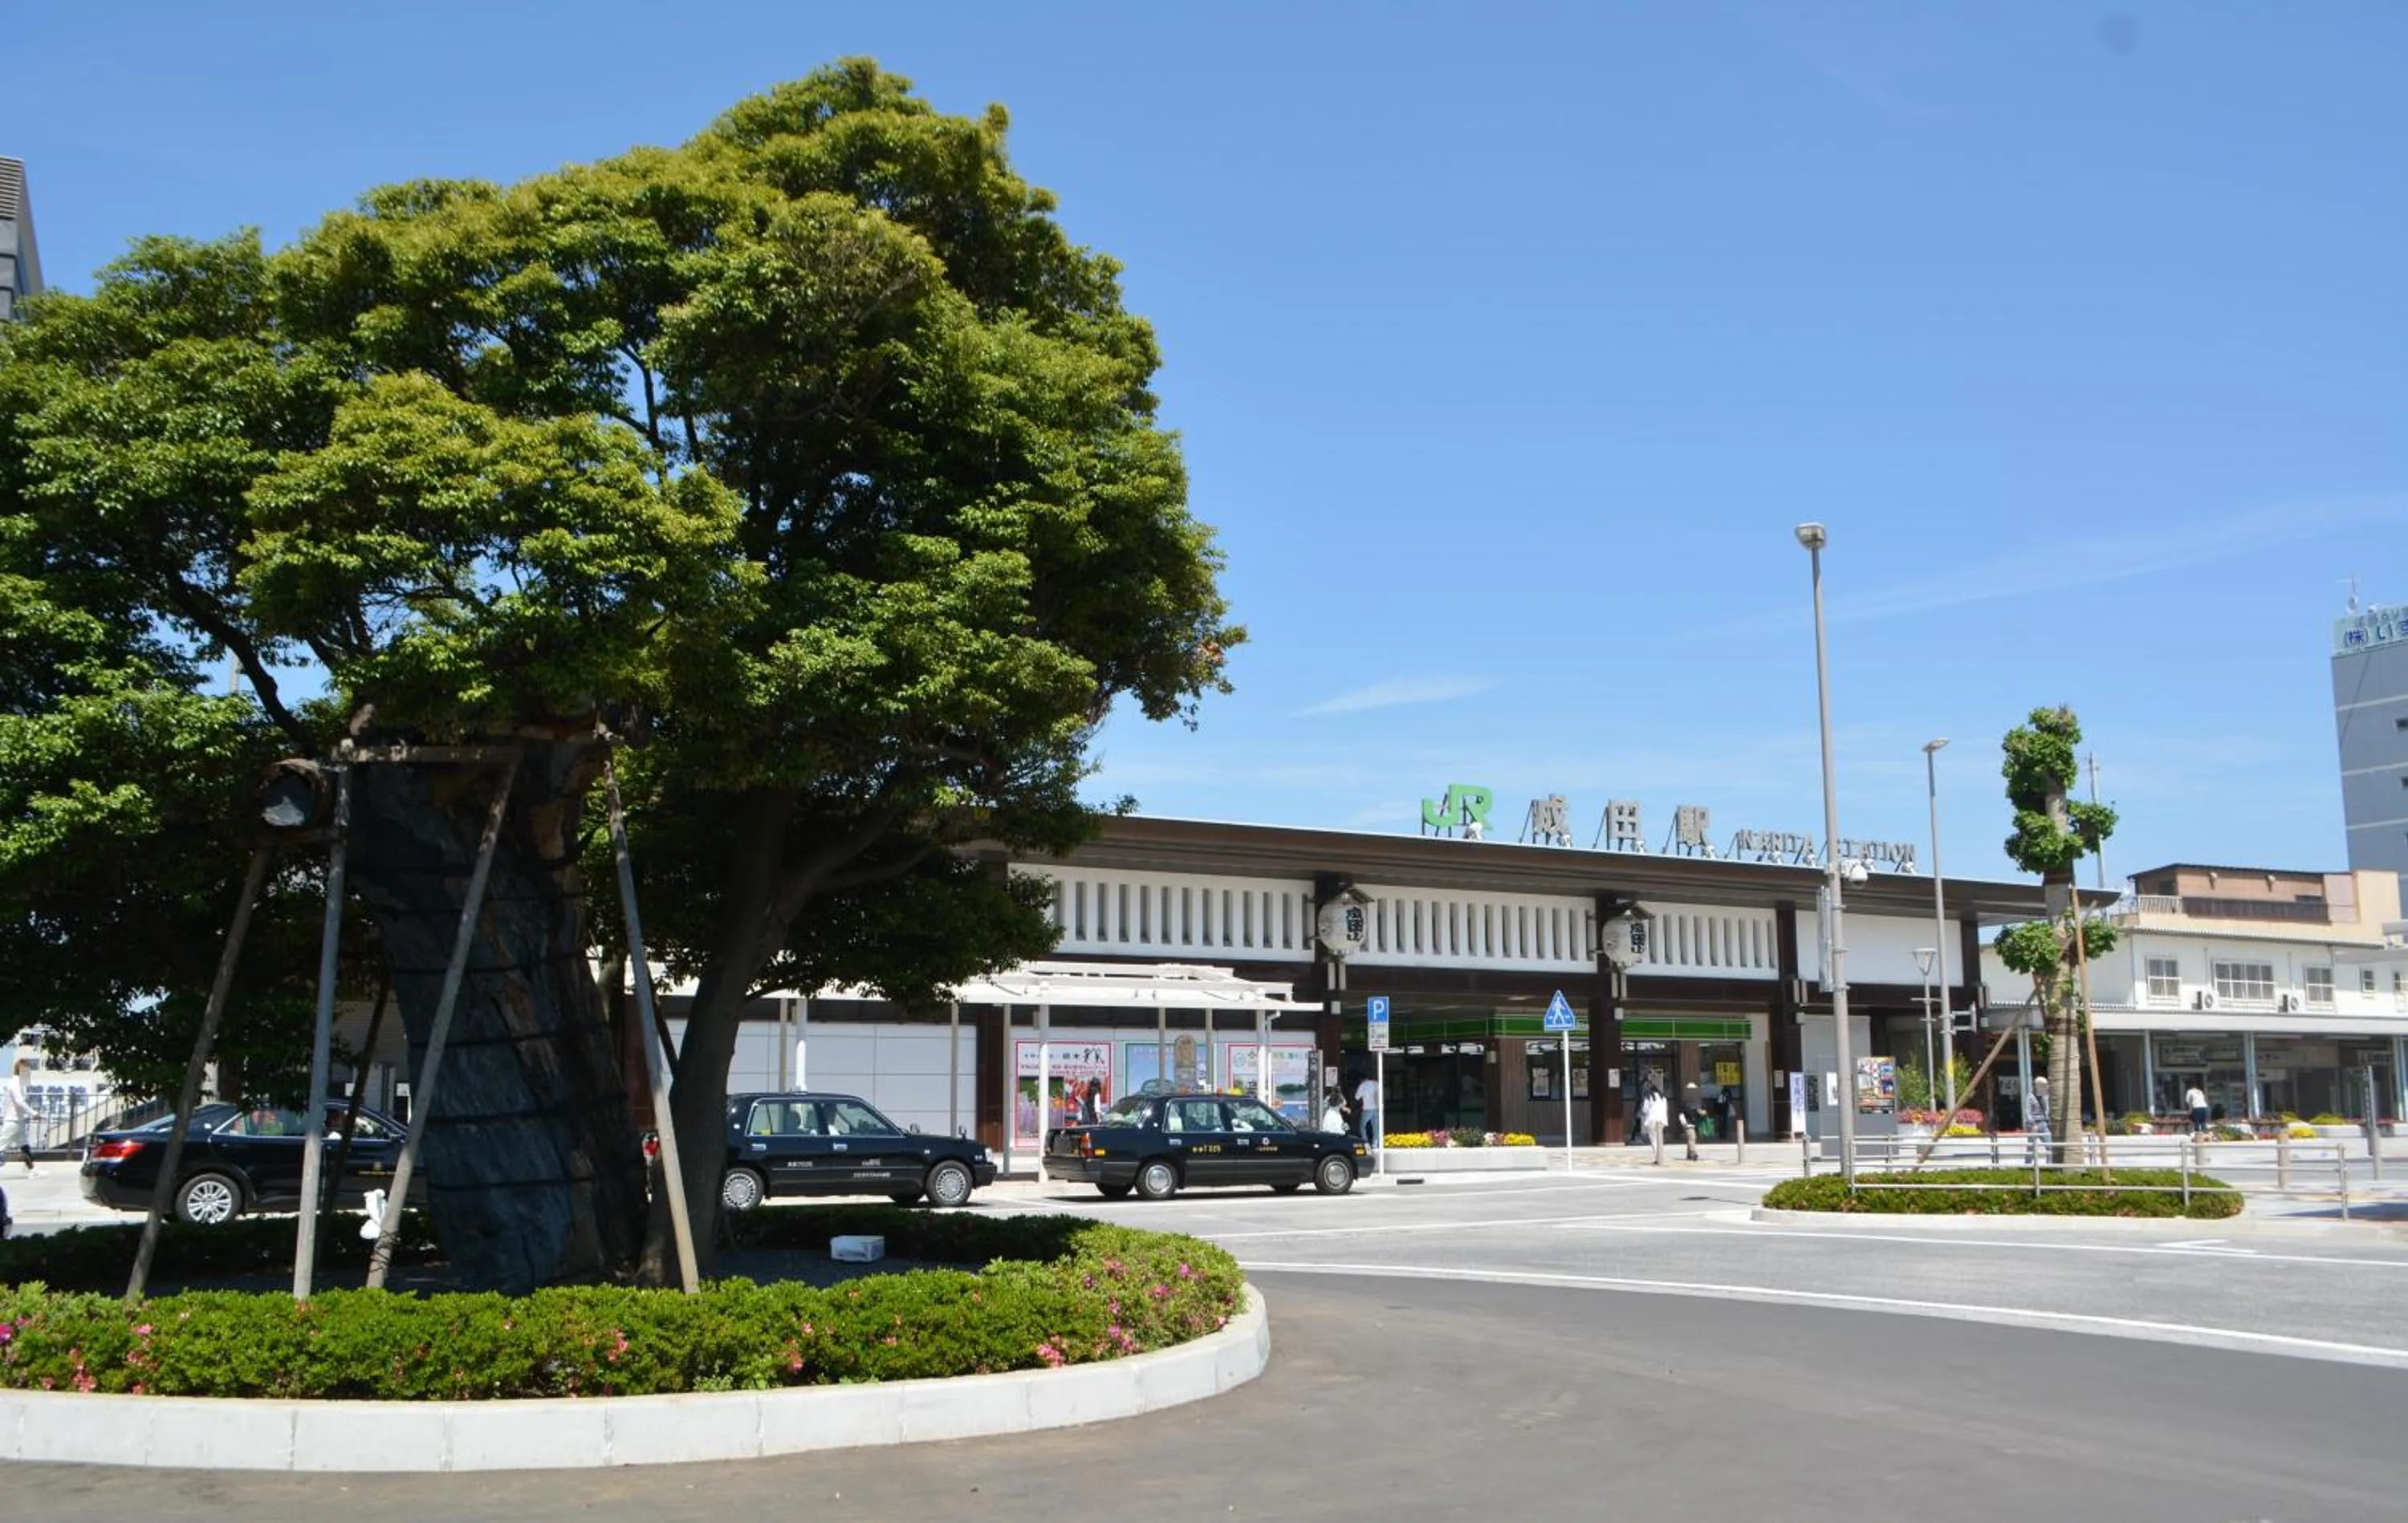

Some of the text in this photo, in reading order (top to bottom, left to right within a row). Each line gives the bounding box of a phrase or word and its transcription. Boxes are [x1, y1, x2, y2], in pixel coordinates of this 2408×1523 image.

[1423, 784, 1492, 830] JR
[1531, 794, 1710, 847] 成田駅
[1739, 829, 1814, 856] NARITA
[1373, 1001, 1385, 1020] P
